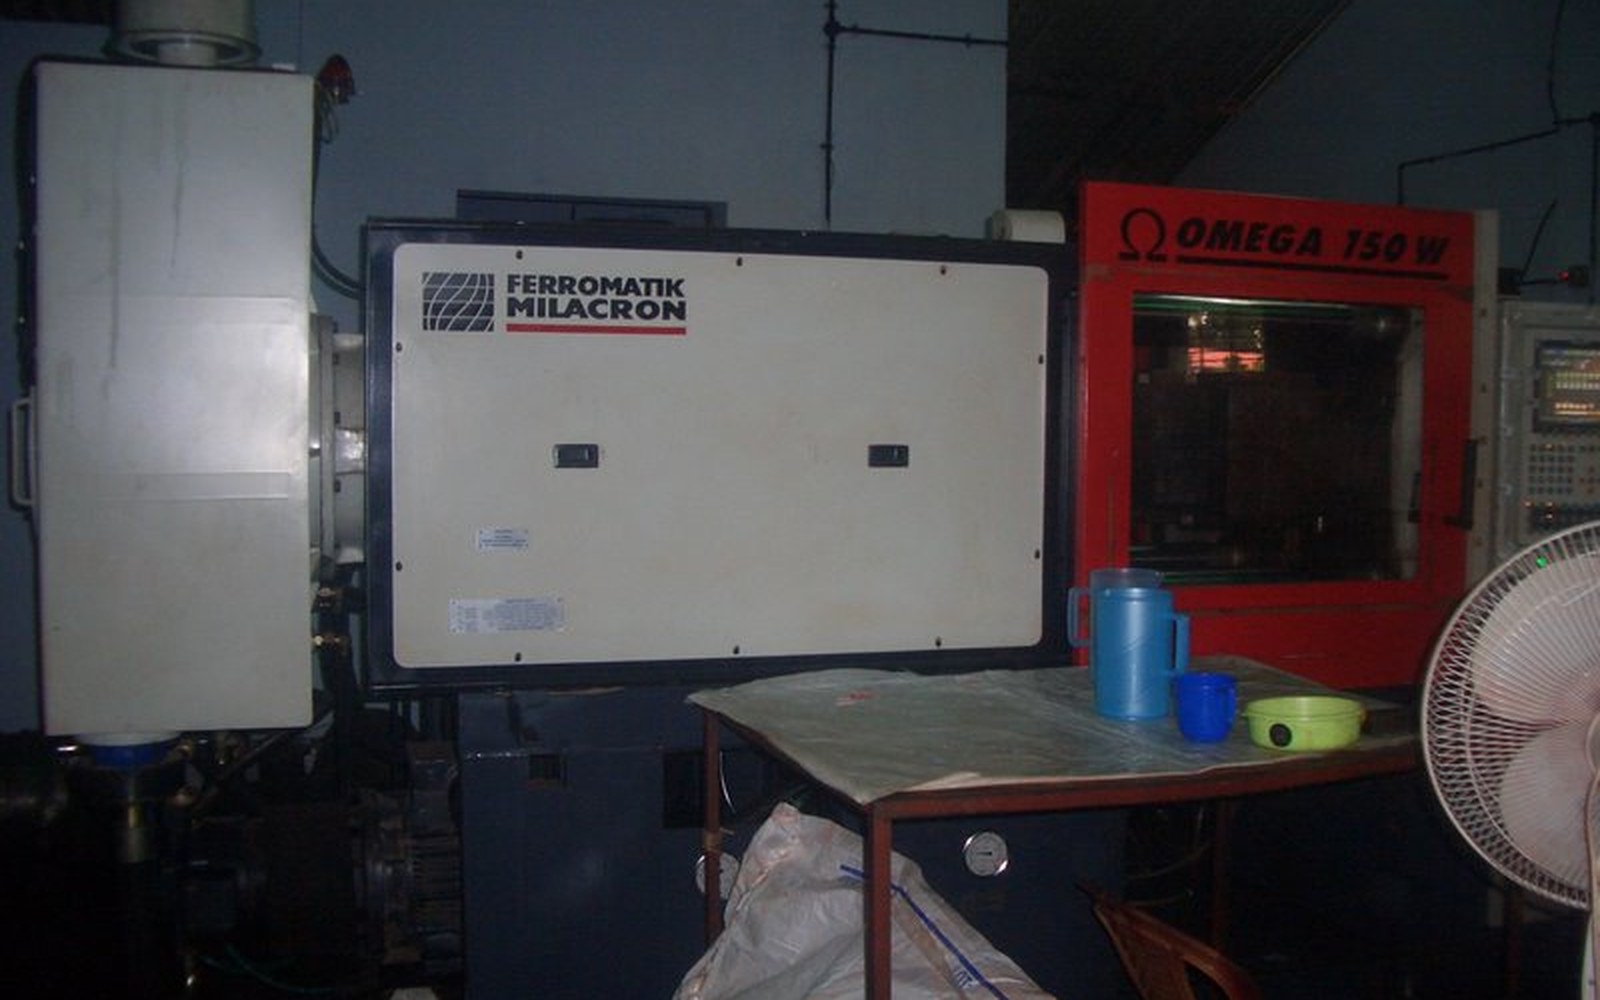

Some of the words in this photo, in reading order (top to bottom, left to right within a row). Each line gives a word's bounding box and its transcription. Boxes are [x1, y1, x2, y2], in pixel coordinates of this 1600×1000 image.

[1177, 217, 1322, 257] OMEGA
[1344, 229, 1408, 264] 150
[1416, 236, 1450, 266] W
[507, 273, 686, 298] FERROMATIK
[507, 297, 687, 321] MILACRON
